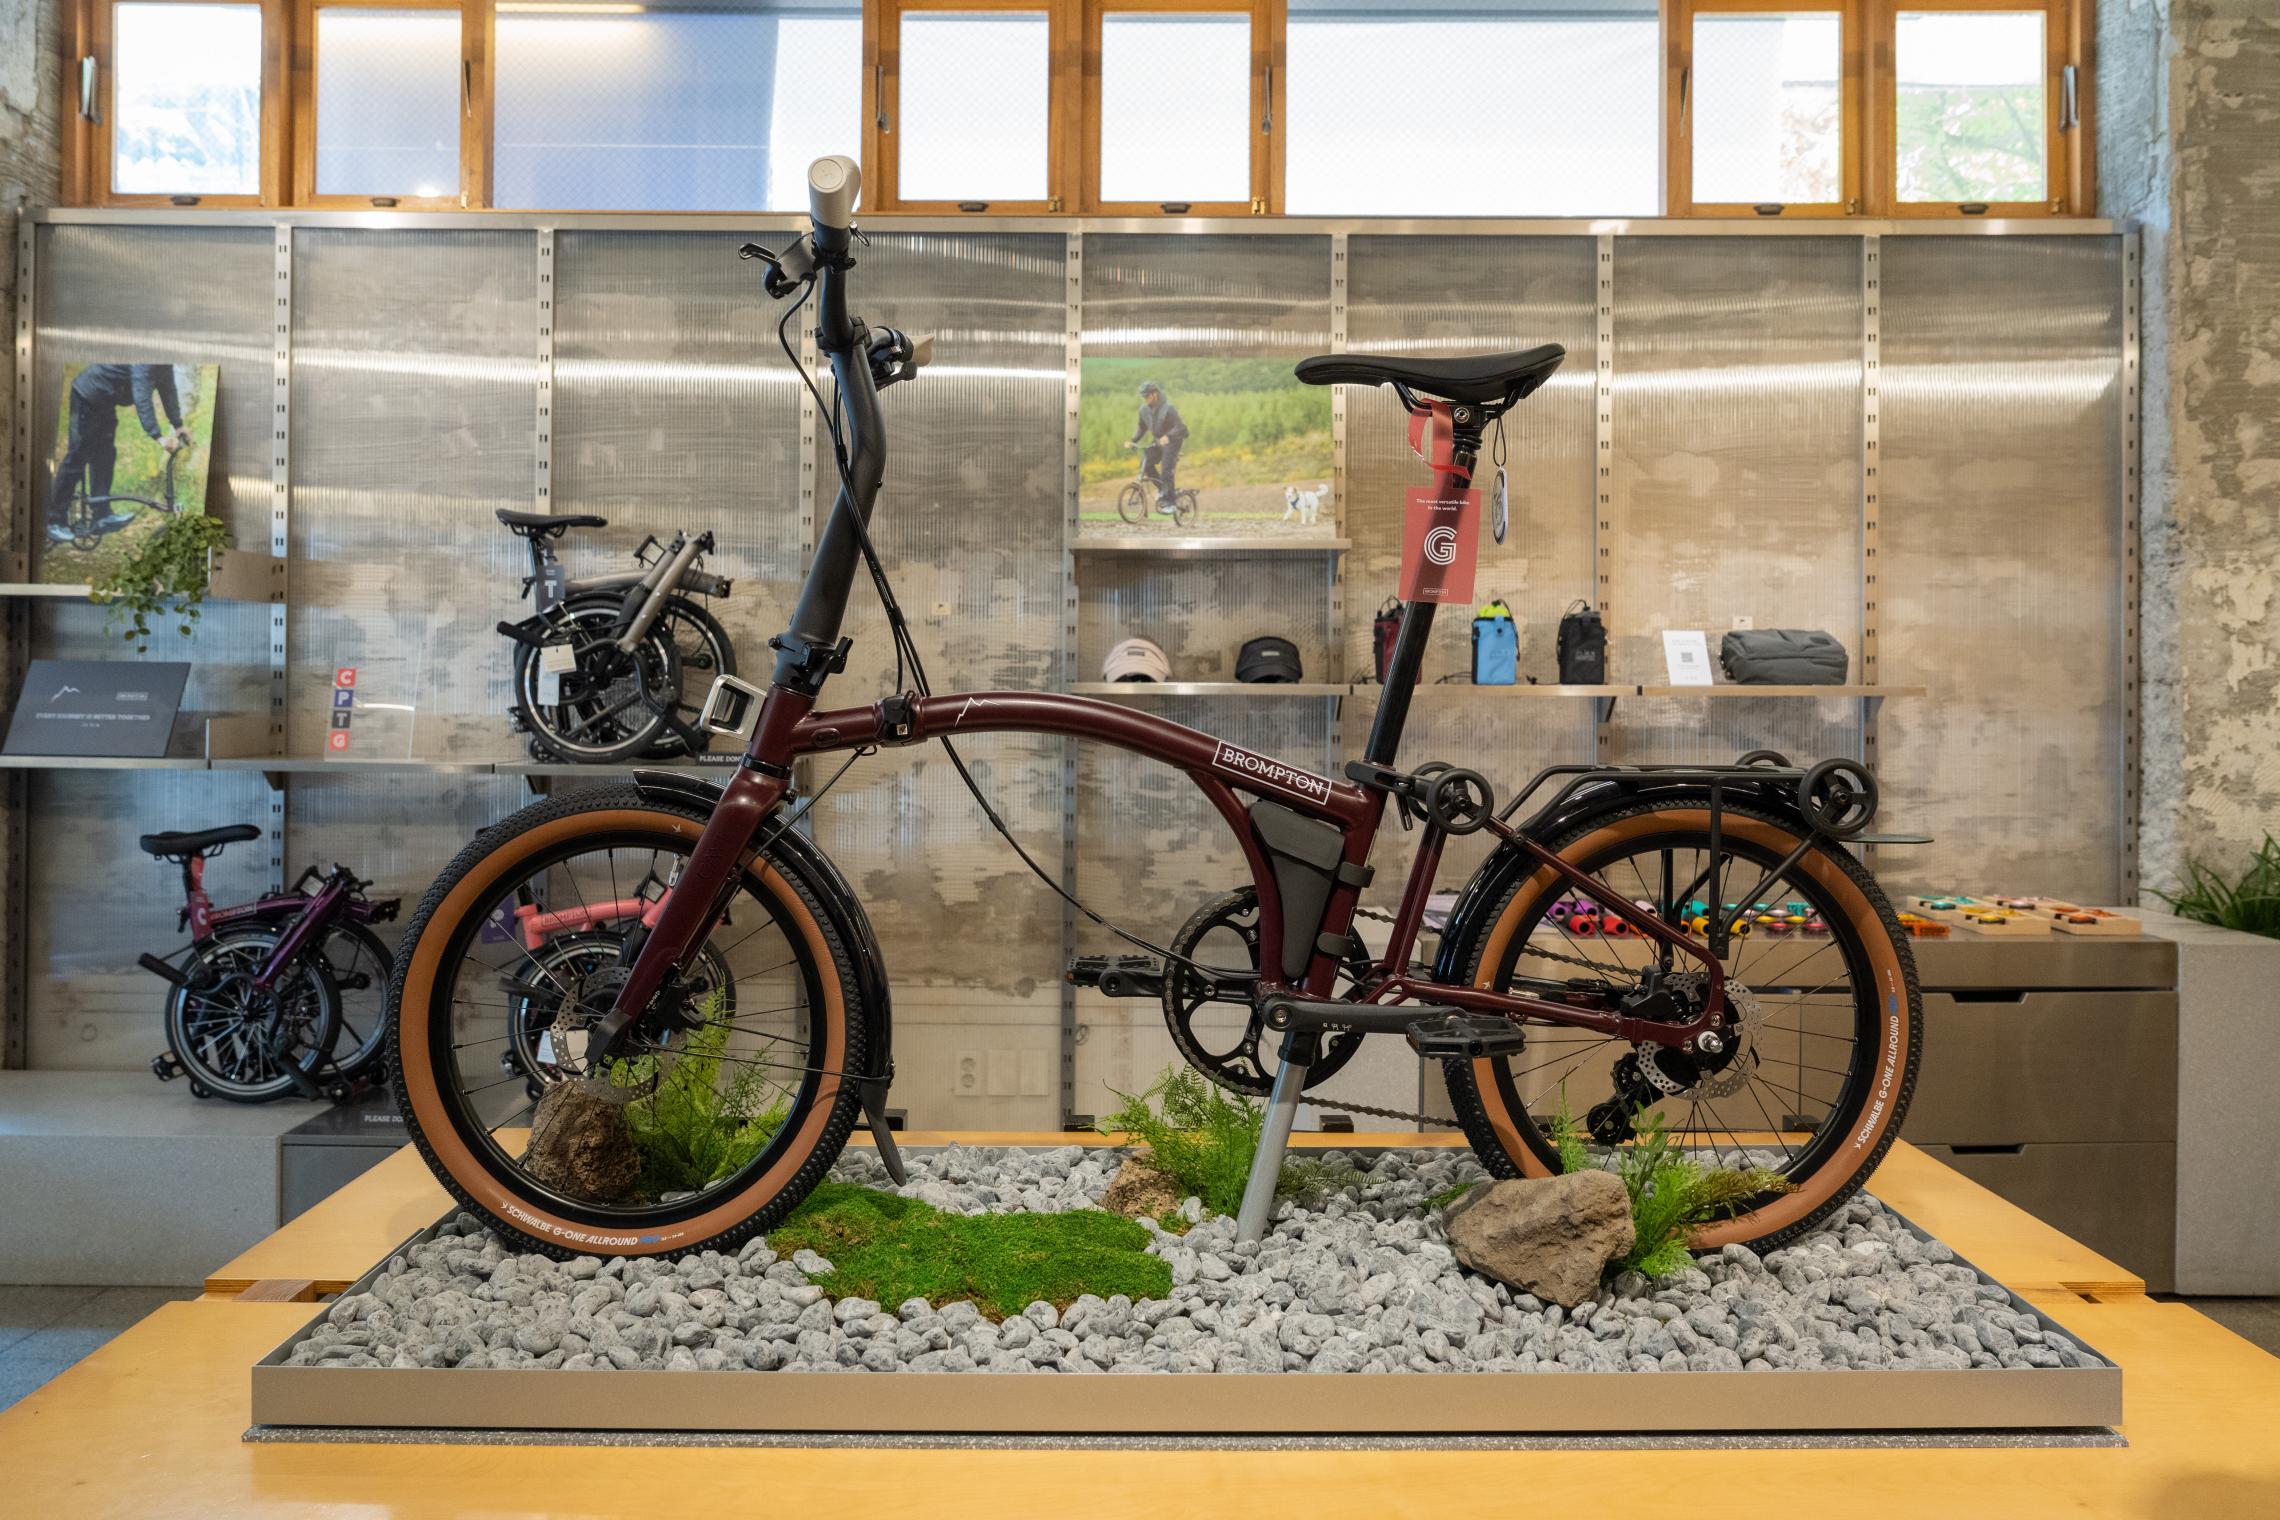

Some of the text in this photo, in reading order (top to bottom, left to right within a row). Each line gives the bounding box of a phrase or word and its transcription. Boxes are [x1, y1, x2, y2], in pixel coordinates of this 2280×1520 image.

[1424, 526, 1457, 565] G
[338, 691, 349, 705] P
[336, 713, 347, 726] T
[1222, 748, 1323, 795] BROMPTON
[1857, 1100, 1885, 1144] SCHWALBE
[1878, 1064, 1894, 1099] G-ONE
[1889, 1015, 1899, 1067] ALLROUND
[507, 1206, 551, 1232] SCHWALBE
[552, 1227, 587, 1243] G-ONE
[586, 1235, 638, 1246] ALLROUND
